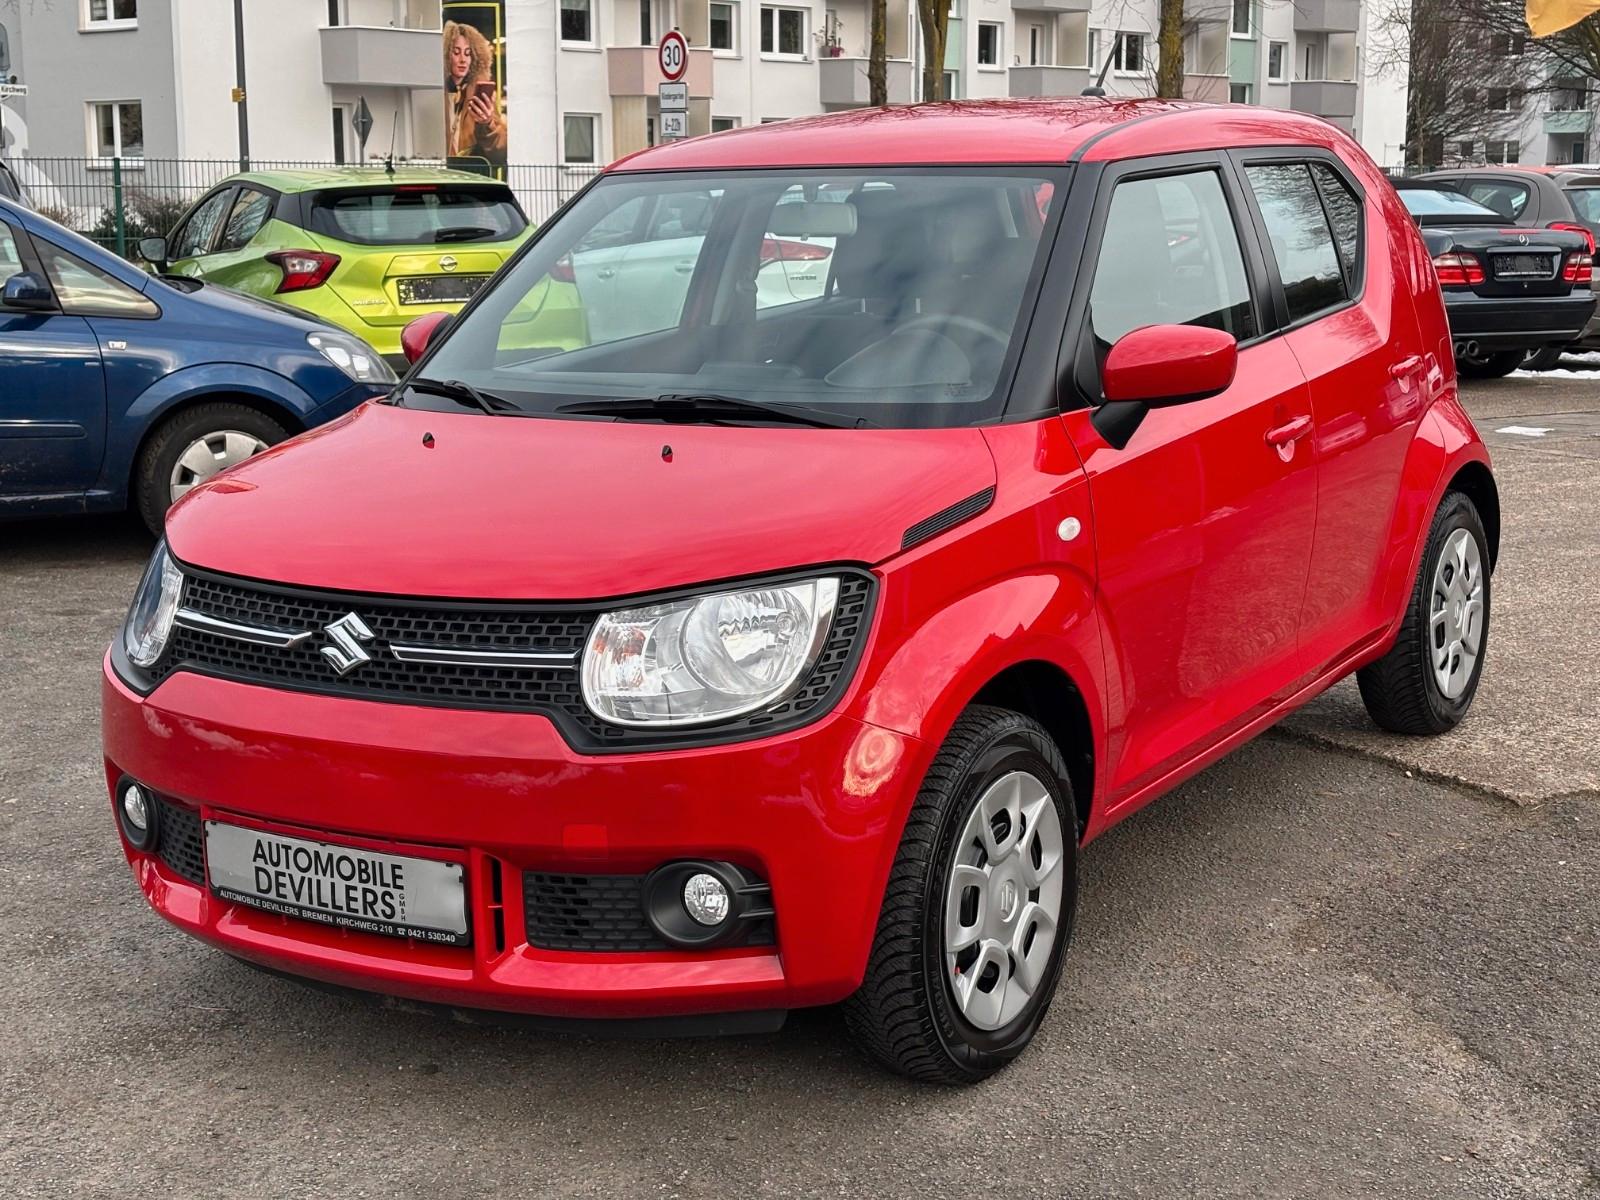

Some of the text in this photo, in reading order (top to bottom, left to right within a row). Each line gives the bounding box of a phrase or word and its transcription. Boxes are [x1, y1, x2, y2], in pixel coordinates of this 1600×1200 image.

[664, 45, 681, 67] 30
[252, 839, 405, 890] AUTOMOBILE
[220, 890, 456, 943] AUTOMOBILE DEVILLERS BREMEN KIRCHWEG 210 0421 530340
[254, 866, 395, 920] DEVILLERS
